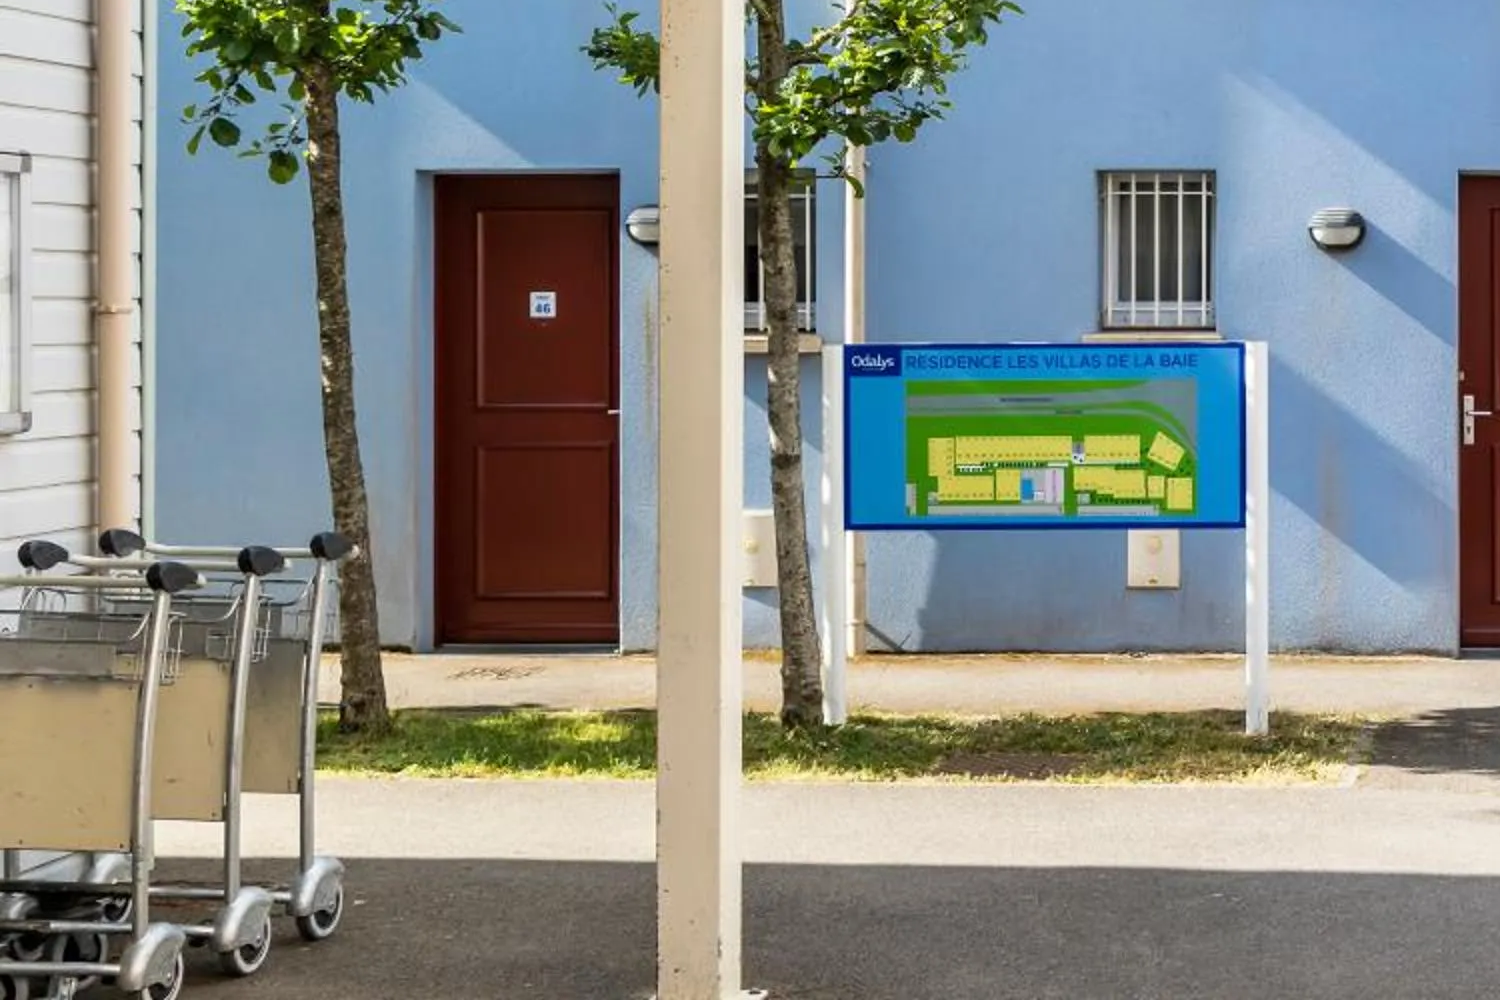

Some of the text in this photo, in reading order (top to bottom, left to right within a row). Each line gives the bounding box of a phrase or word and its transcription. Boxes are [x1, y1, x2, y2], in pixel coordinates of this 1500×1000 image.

[534, 303, 551, 314] 46
[851, 354, 895, 371] Odalys
[1007, 355, 1039, 369] LES
[1043, 354, 1101, 369] VILLAS
[1106, 353, 1129, 368] DE
[1133, 353, 1155, 368] LA
[1160, 353, 1199, 368] BAIE
